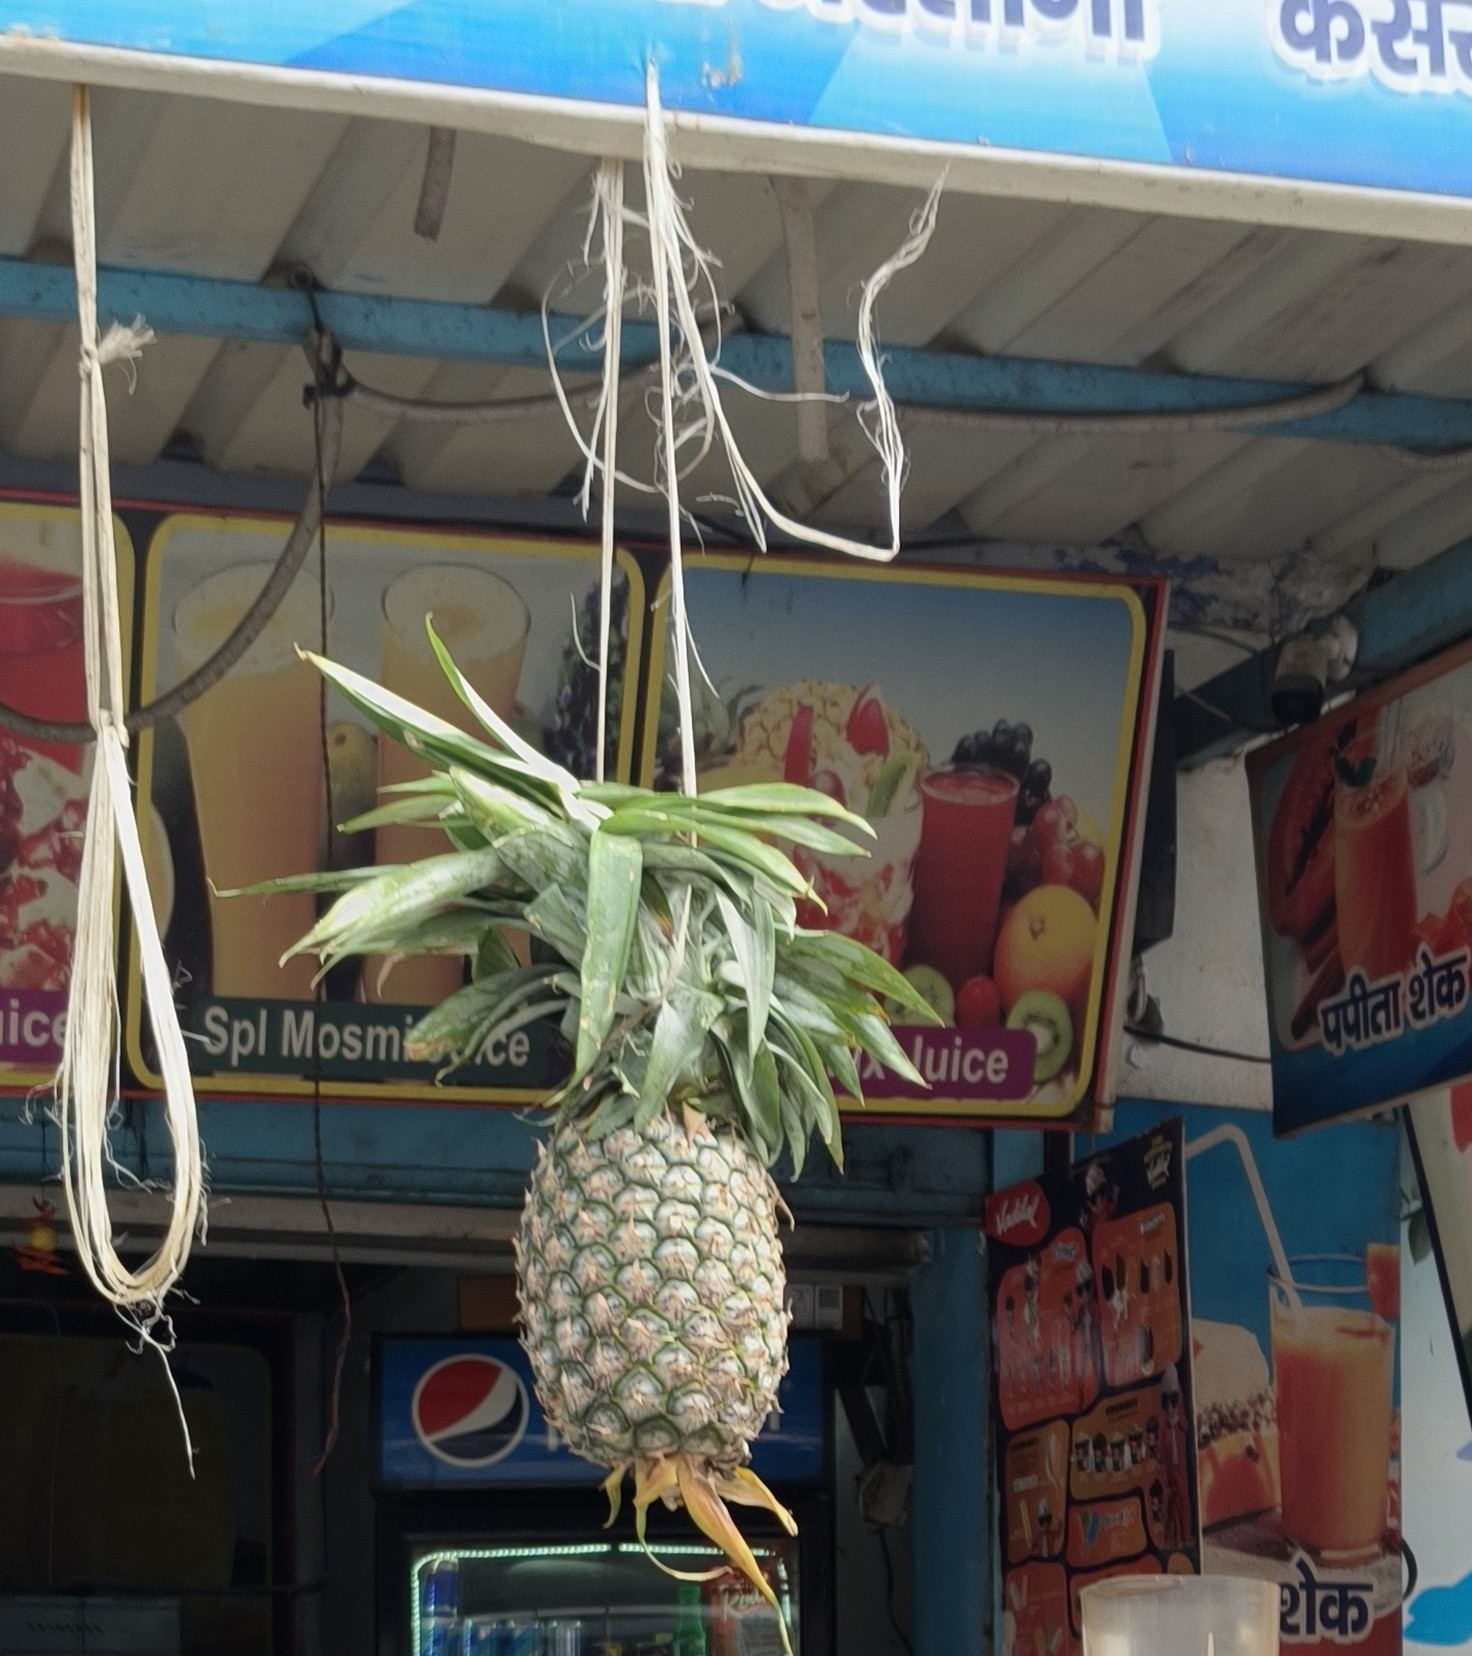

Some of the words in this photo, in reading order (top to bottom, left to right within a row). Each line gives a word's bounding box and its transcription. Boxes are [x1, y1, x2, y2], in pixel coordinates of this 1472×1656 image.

[204, 1006, 268, 1067] Spl
[1321, 974, 1401, 1050] पपीता
[1408, 950, 1468, 1032] शेक
